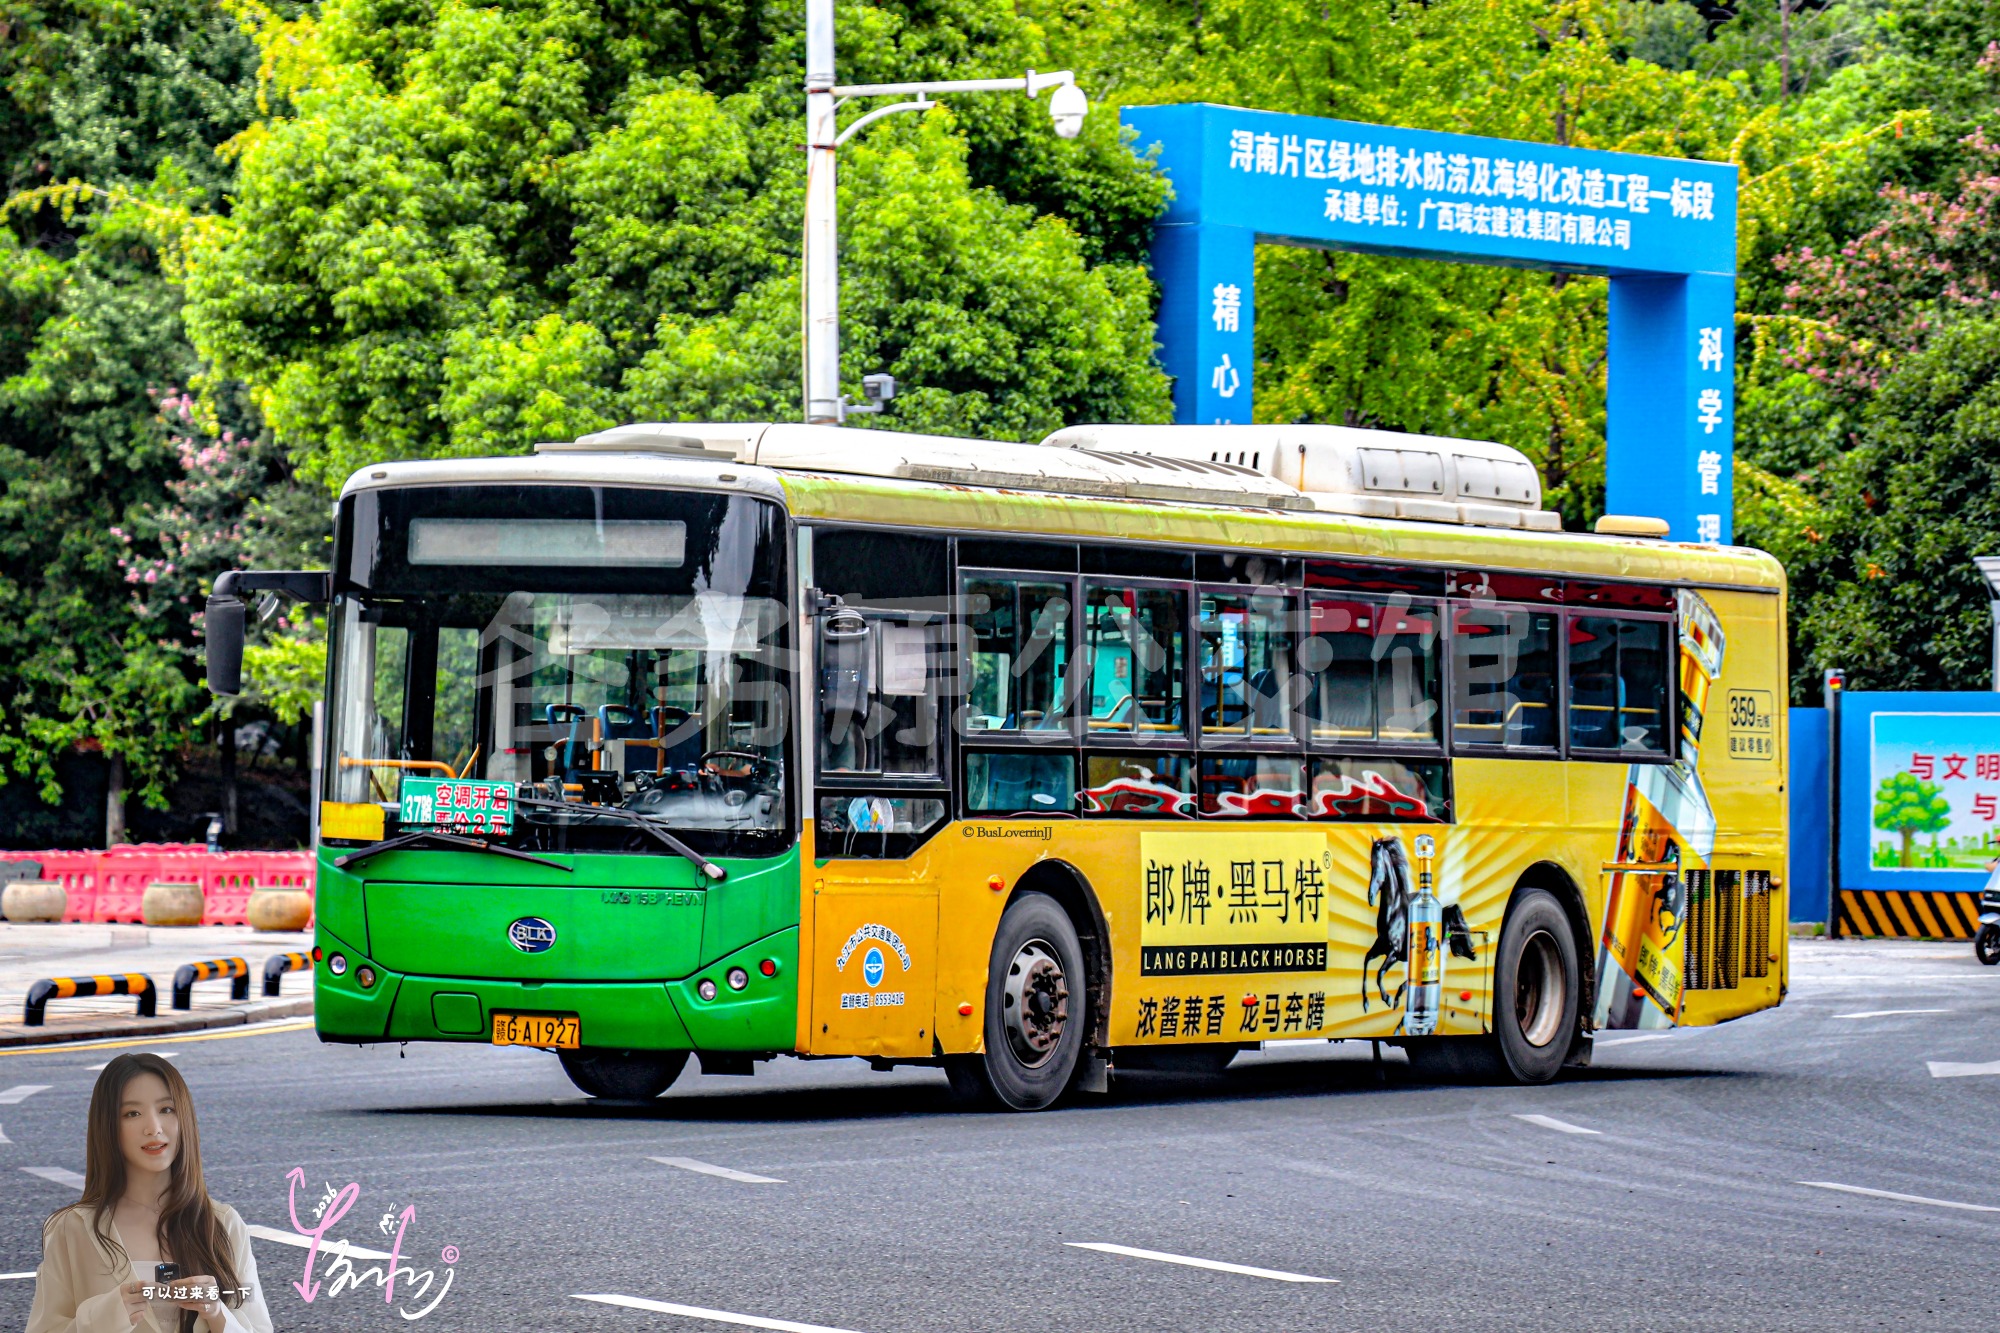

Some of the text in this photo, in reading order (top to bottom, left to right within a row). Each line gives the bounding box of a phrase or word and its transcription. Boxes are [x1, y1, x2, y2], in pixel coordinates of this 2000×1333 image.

[1212, 283, 1242, 424] 精心
[1697, 327, 1724, 545] 科学管理
[1909, 753, 2000, 780] 与文明
[404, 794, 432, 823] 37路
[435, 784, 509, 810] 空调开启
[1971, 793, 1997, 821] 与
[1146, 859, 1325, 926] 郎牌·黑马特
[1144, 948, 1325, 970] LANG PAI BLACK HORSE
[1136, 991, 1325, 1038] 浓酱兼香 龙马奔腾
